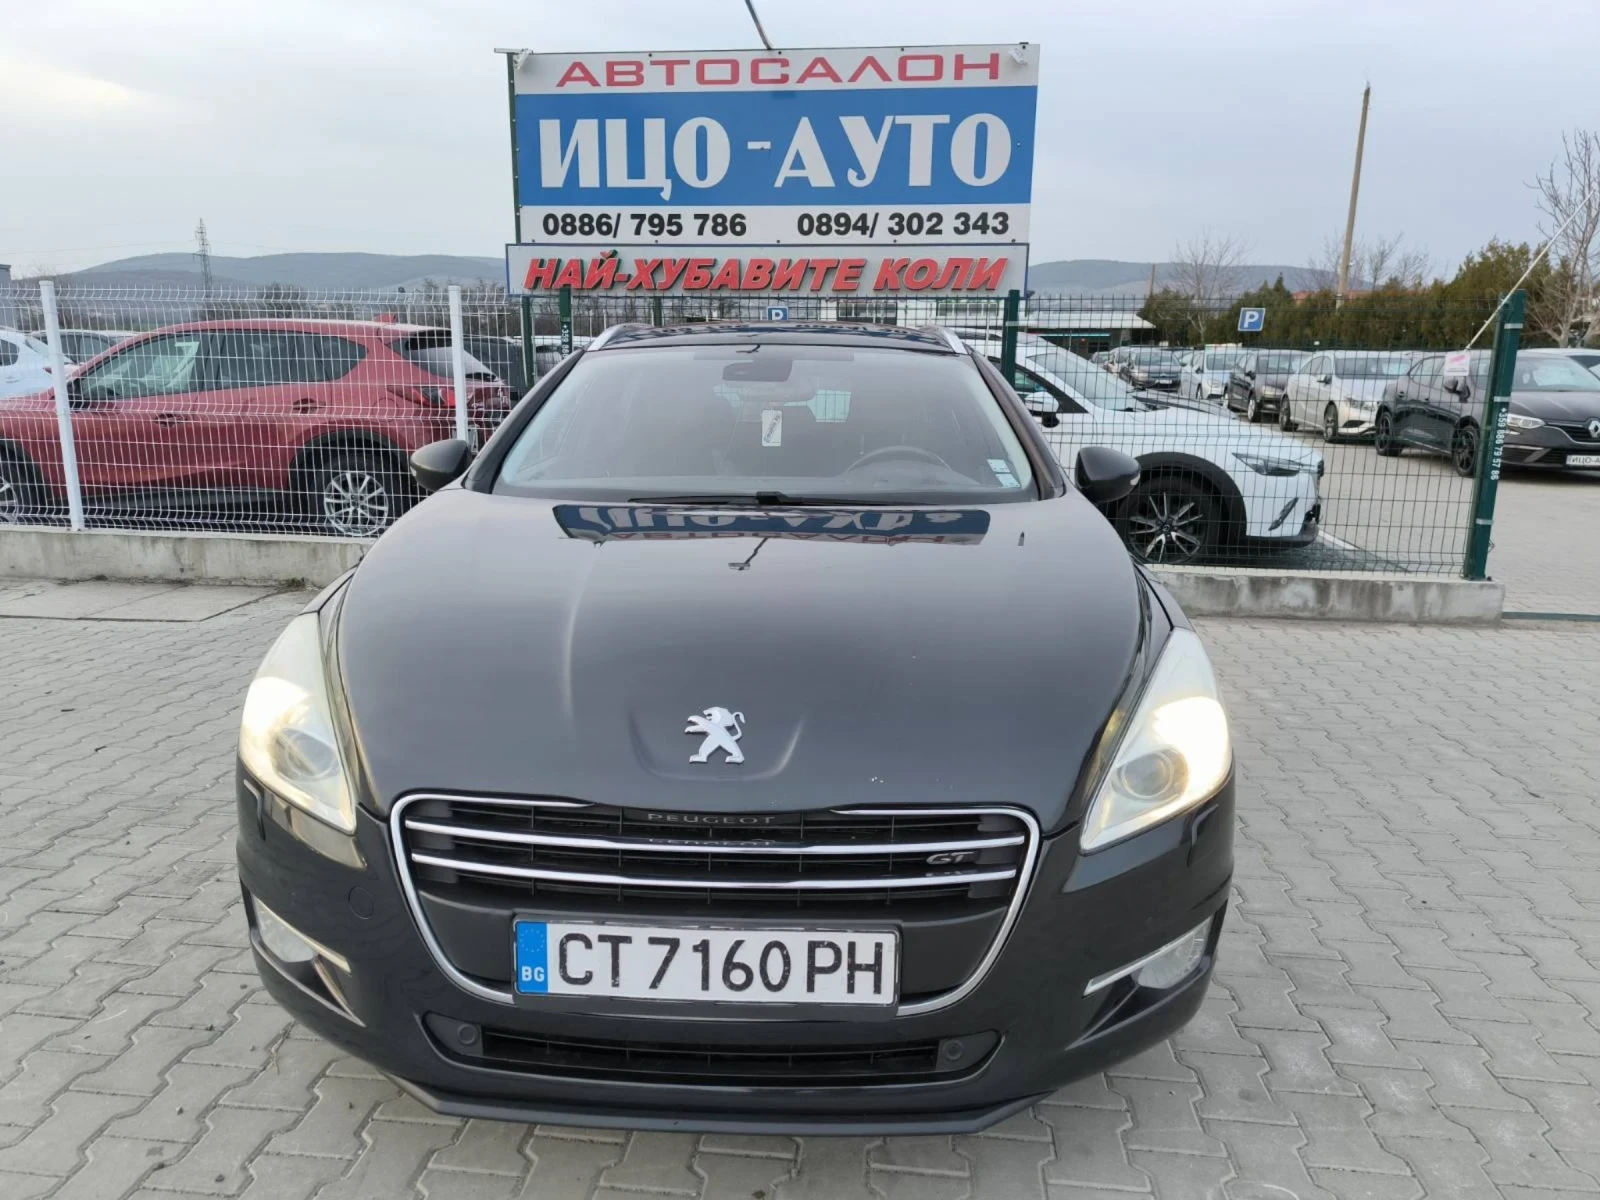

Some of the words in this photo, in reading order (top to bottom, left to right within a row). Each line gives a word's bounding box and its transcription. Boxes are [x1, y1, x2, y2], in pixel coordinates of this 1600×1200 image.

[555, 53, 1000, 88] АВТОСАЛОН
[542, 212, 622, 239] 0886/
[629, 212, 683, 237] 795
[693, 212, 747, 237] 786
[796, 211, 880, 239] 0894/
[887, 211, 944, 236] 302
[952, 210, 1010, 236] 343
[522, 248, 866, 292] НАЙ-ХУБАВИТЕ
[872, 256, 1009, 292] КОЛИ
[1243, 310, 1260, 329] P
[1497, 407, 1508, 427] +359
[1493, 445, 1504, 457] 79
[1491, 457, 1502, 469] 57
[1489, 469, 1501, 481] 86
[647, 812, 776, 825] PEUGEOT
[926, 851, 975, 865] GT
[558, 932, 633, 989] CT
[647, 936, 792, 993] 7160
[805, 939, 884, 996] PH
[520, 965, 546, 983] BG
